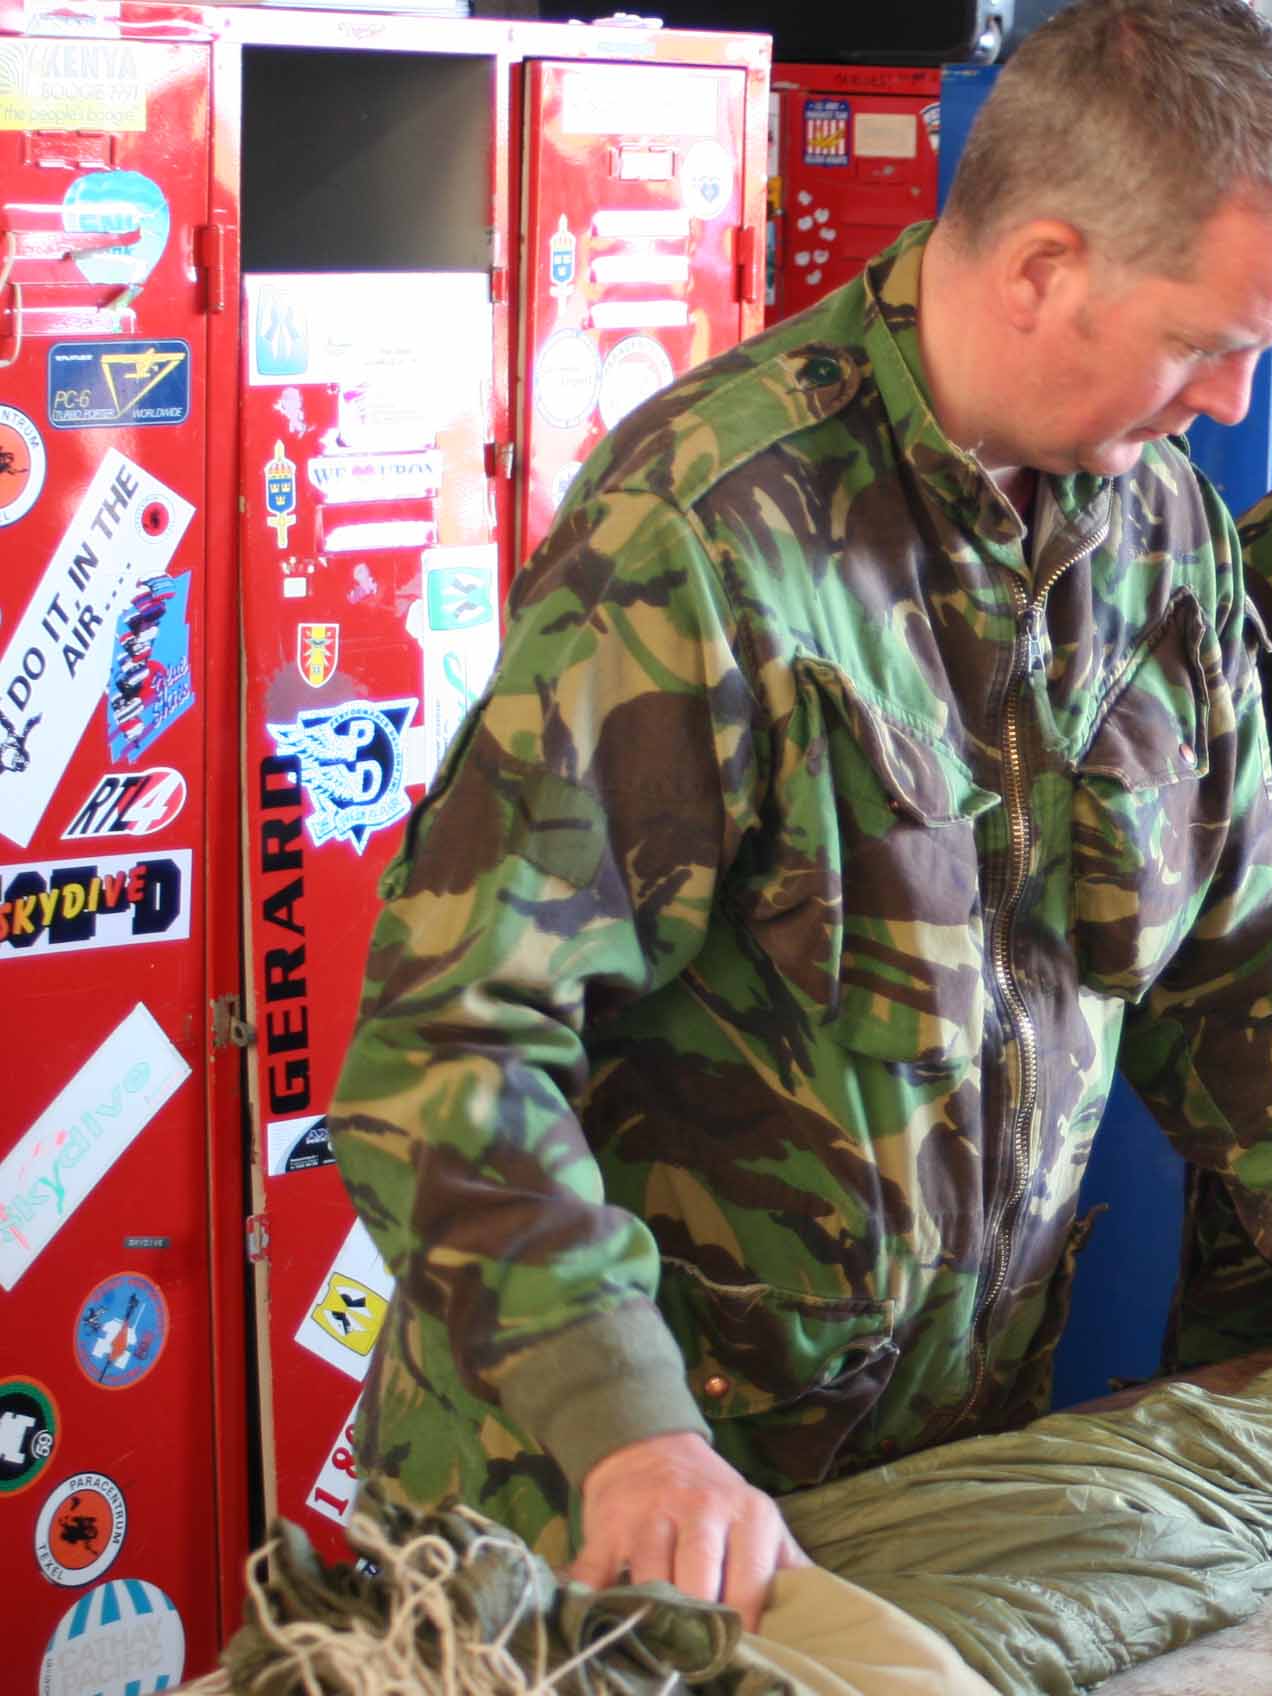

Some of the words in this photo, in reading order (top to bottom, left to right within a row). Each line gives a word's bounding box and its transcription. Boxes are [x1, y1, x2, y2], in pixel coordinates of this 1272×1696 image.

[39, 46, 137, 79] KENYA
[54, 388, 92, 409] PC-6
[132, 407, 184, 419] WORLDWIDE
[67, 541, 99, 593] IN
[90, 464, 139, 541] THE
[0, 864, 149, 943] SKYDIVE
[260, 754, 311, 1115] GERARD
[69, 1476, 124, 1545] PARACENTRUM
[38, 1543, 65, 1581] TEXEL
